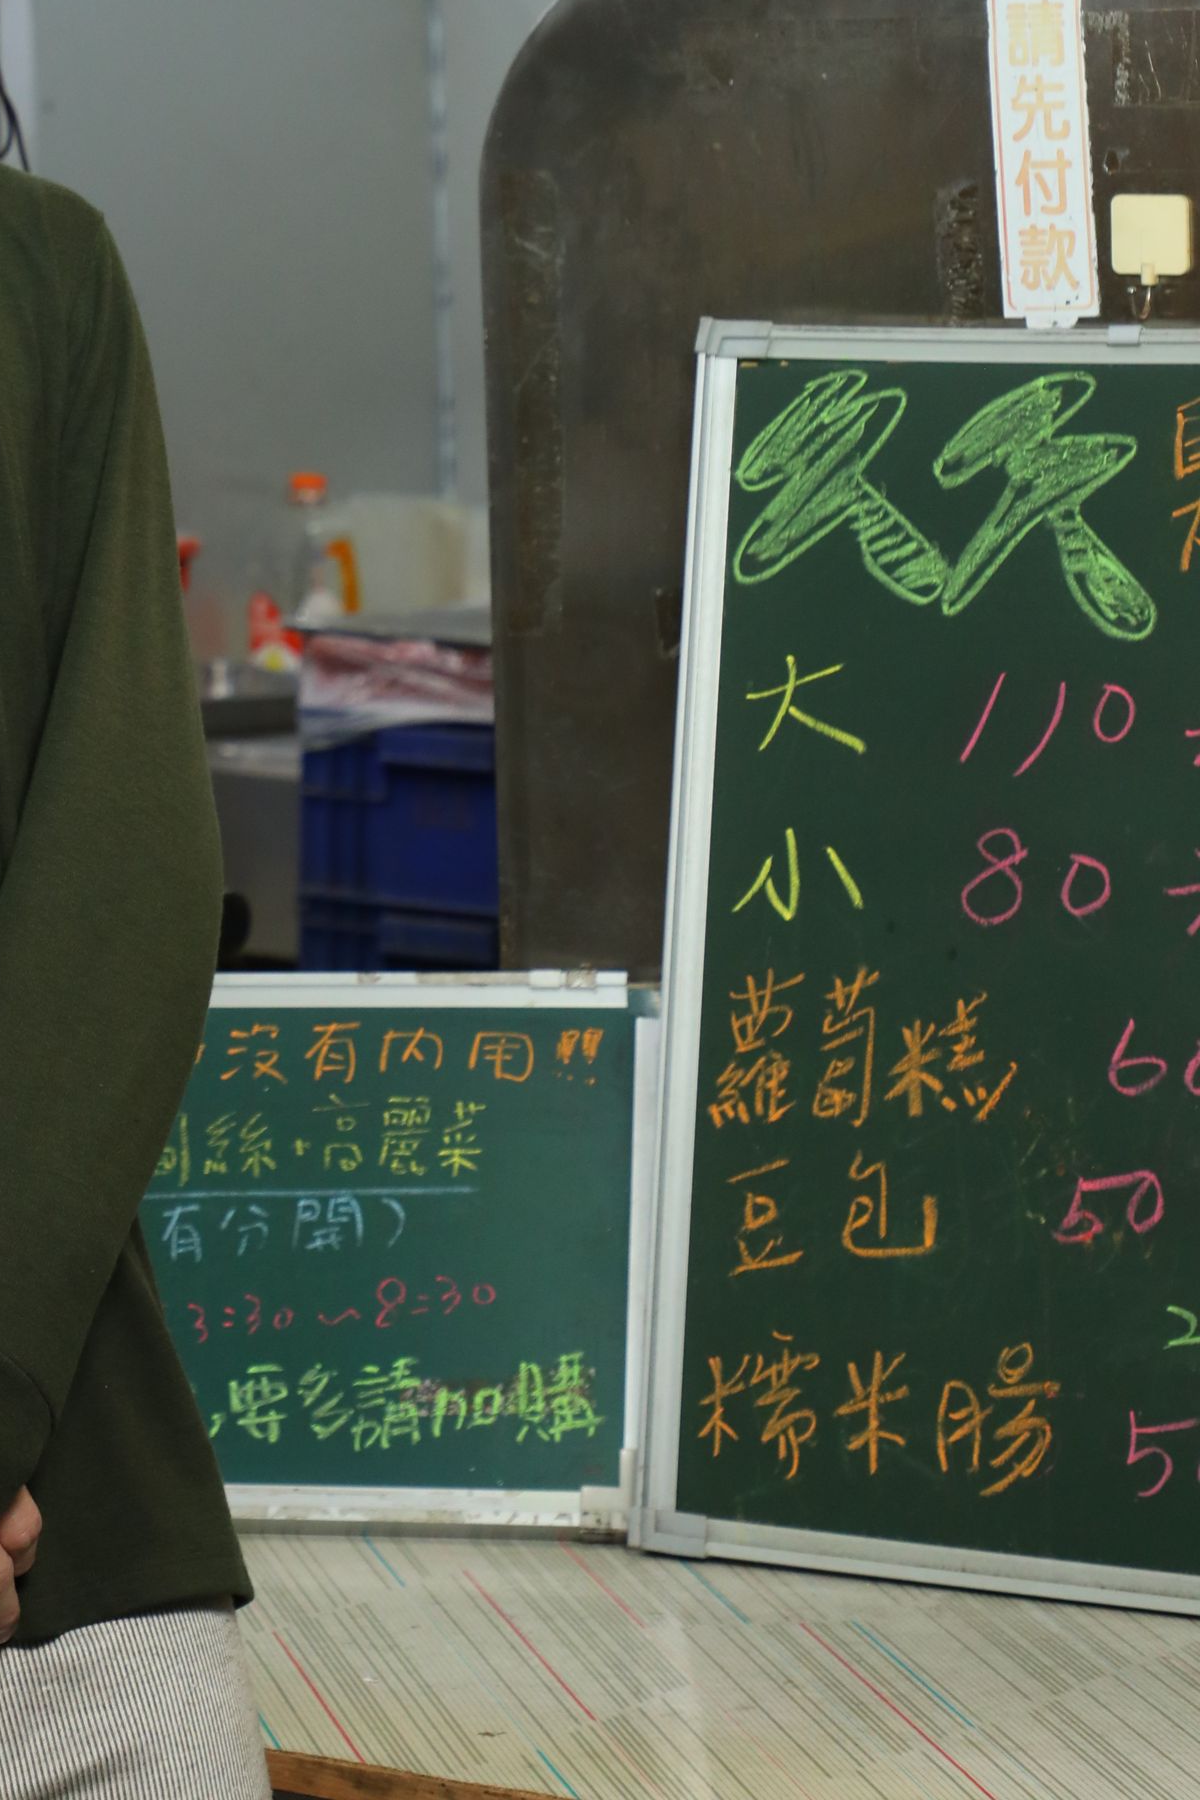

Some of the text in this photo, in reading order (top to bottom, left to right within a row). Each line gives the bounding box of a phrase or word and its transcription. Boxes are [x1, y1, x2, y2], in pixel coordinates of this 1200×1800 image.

[745, 654, 867, 754] 大
[958, 672, 1136, 778] 110
[731, 827, 864, 922] 小
[960, 827, 1112, 926] 80
[726, 1149, 1165, 1278] 豆包 50
